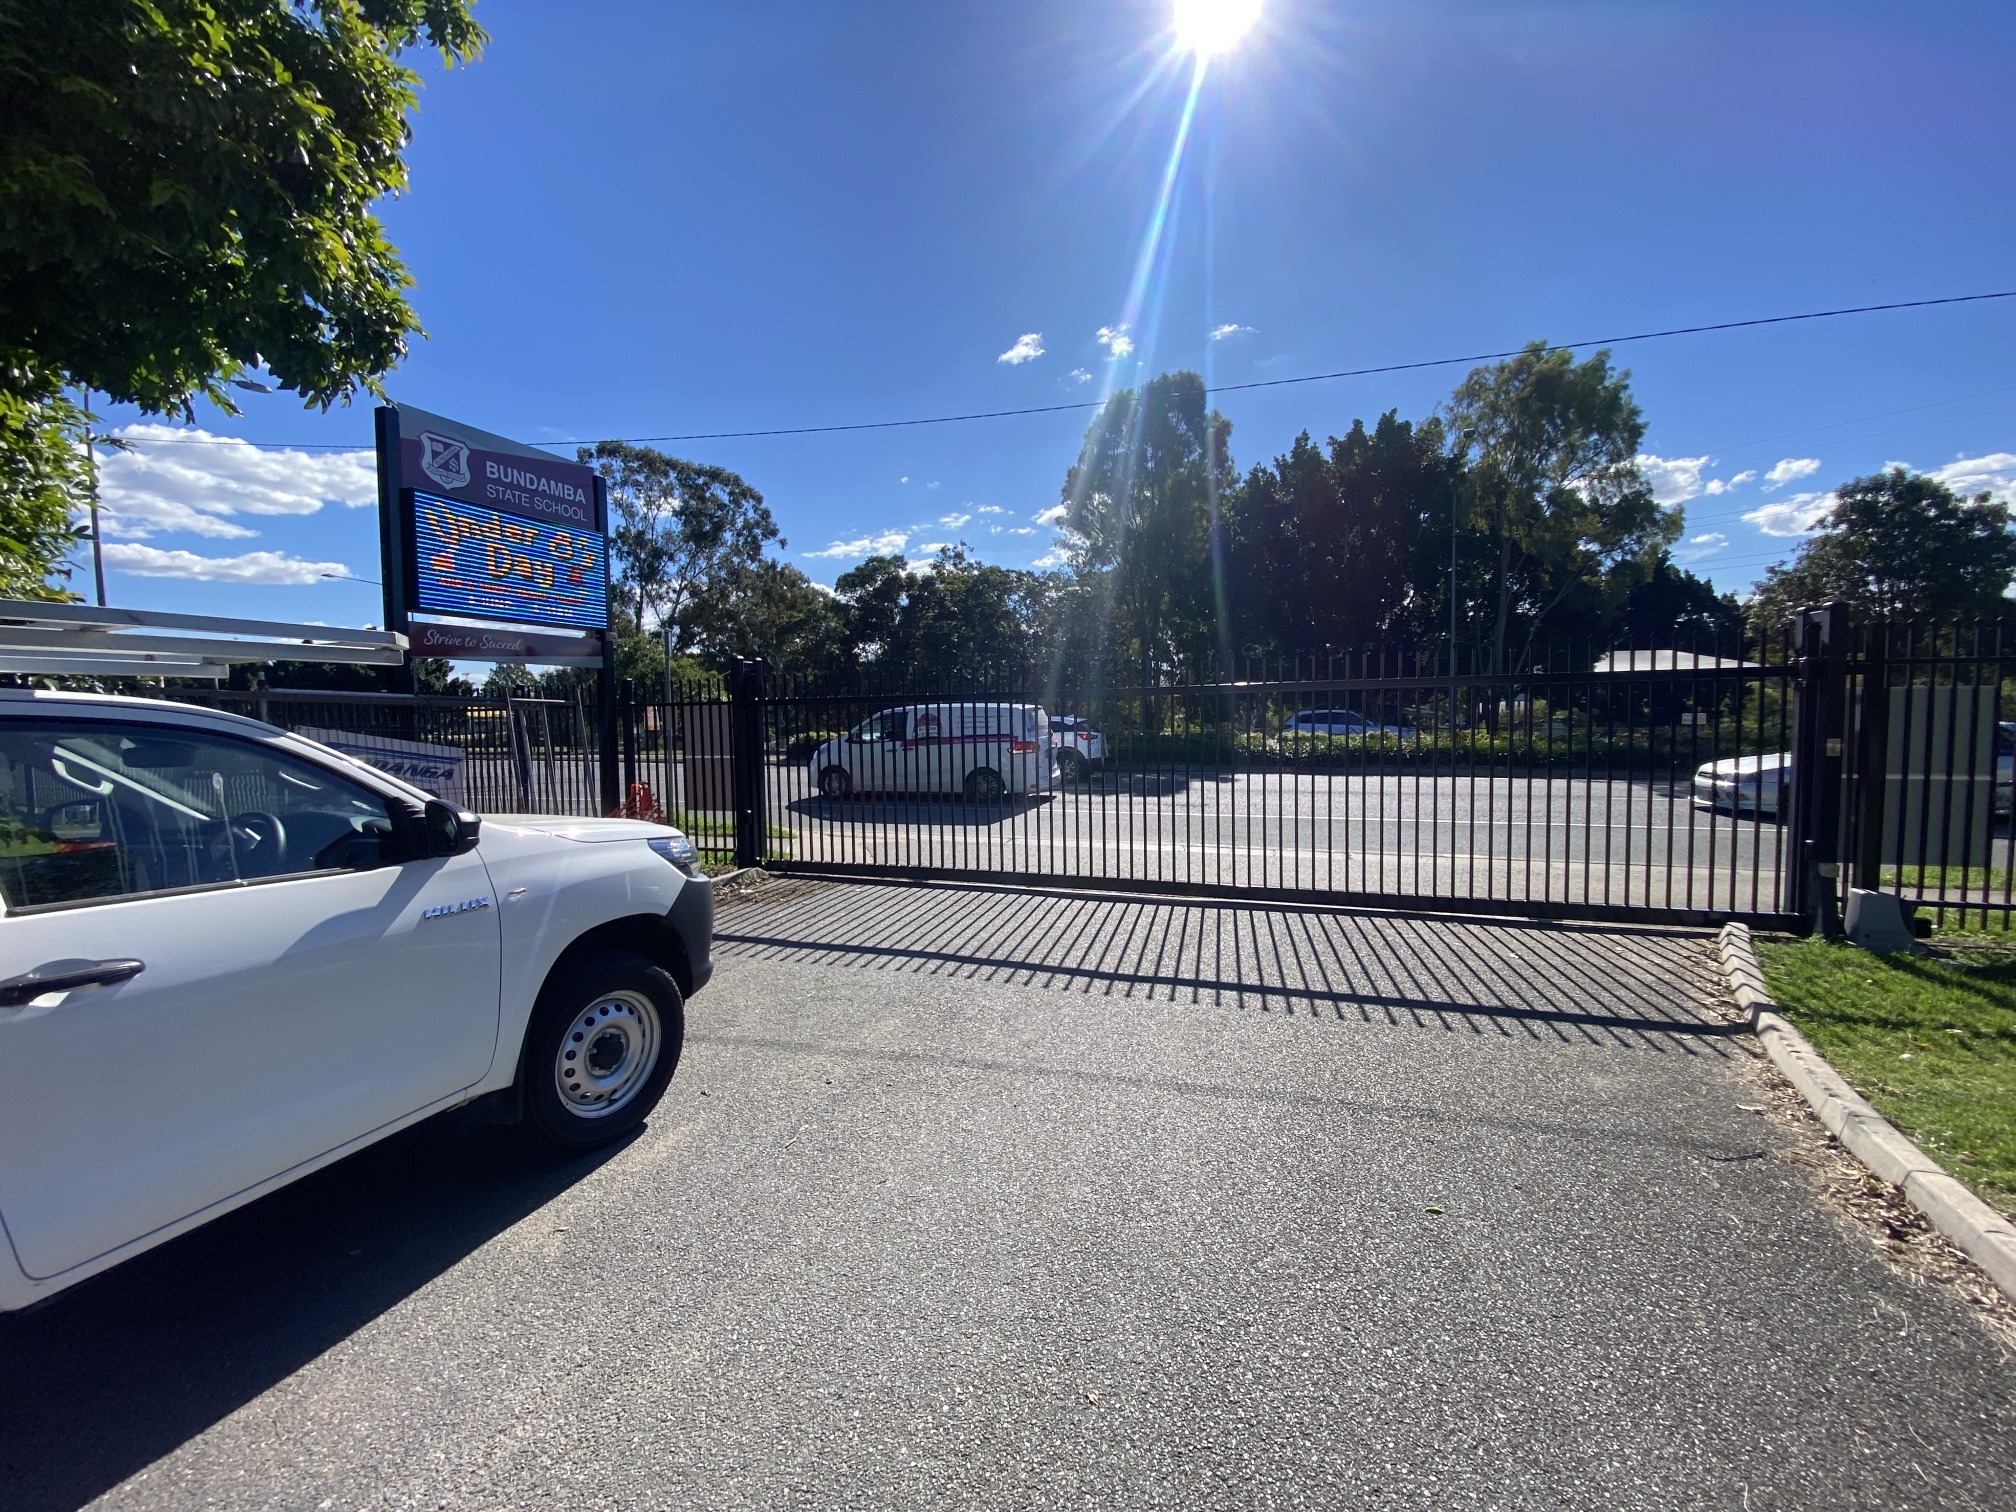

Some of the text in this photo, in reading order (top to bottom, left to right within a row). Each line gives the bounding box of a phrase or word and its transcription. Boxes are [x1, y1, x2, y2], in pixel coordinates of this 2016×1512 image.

[486, 461, 586, 504] BUNDAMBA
[487, 484, 587, 521] STATE SCHOOL
[425, 502, 539, 545] Under
[486, 541, 553, 587] Day
[424, 629, 463, 647] Strive
[465, 636, 476, 647] to
